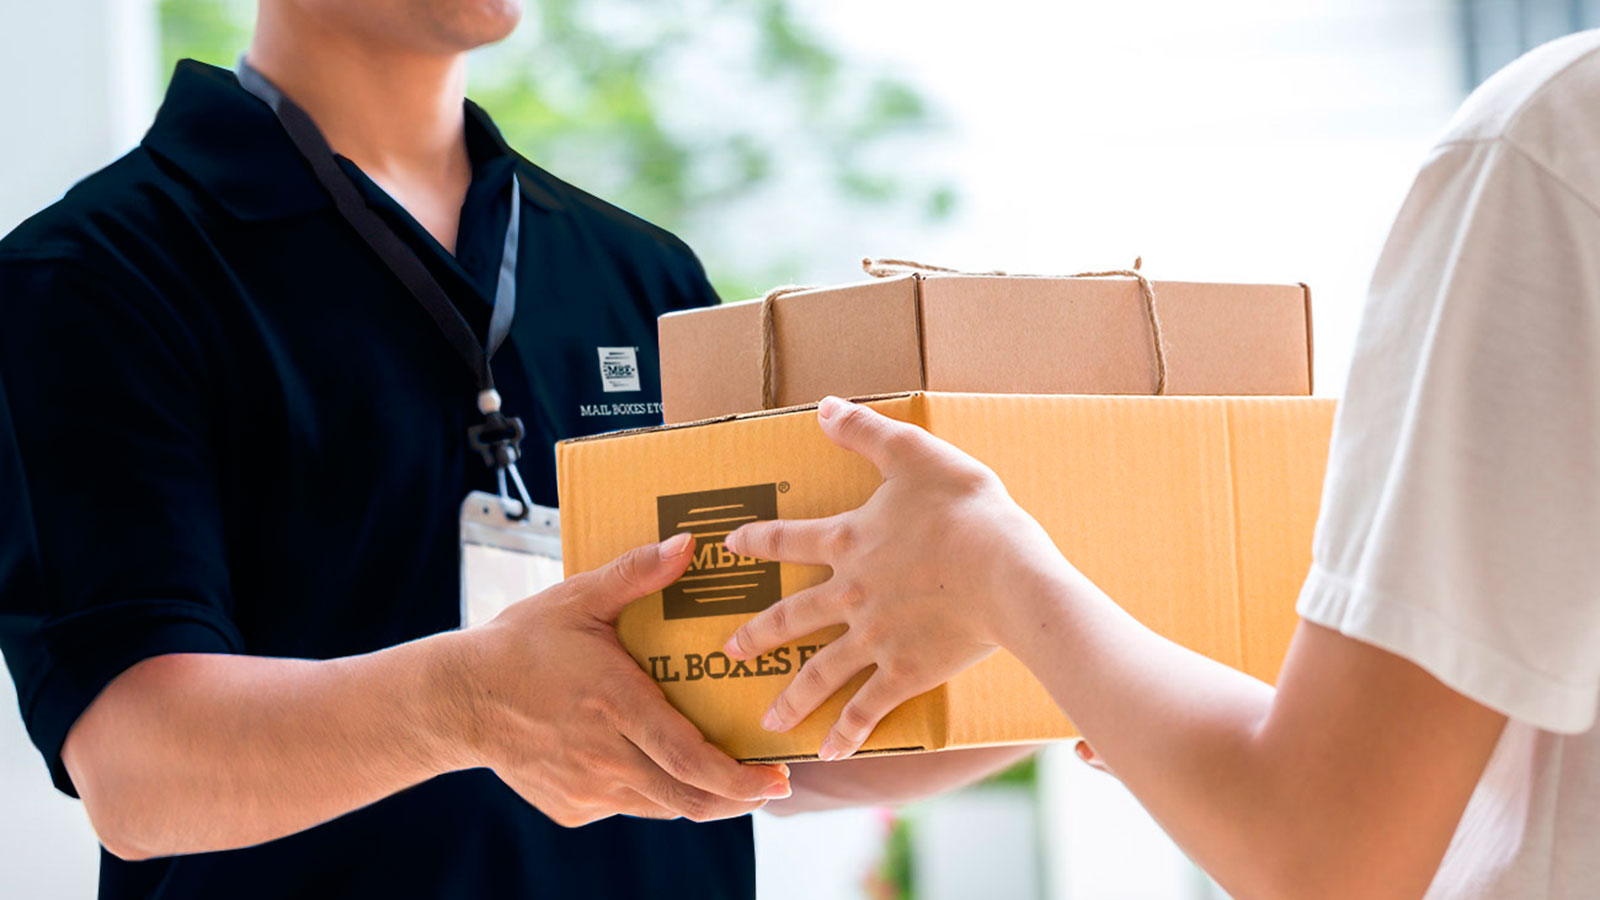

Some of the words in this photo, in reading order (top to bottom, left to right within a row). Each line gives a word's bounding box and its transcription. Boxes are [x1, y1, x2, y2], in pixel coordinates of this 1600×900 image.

[580, 404, 611, 416] MAIL
[612, 403, 646, 415] BOXES
[648, 655, 680, 682] IL
